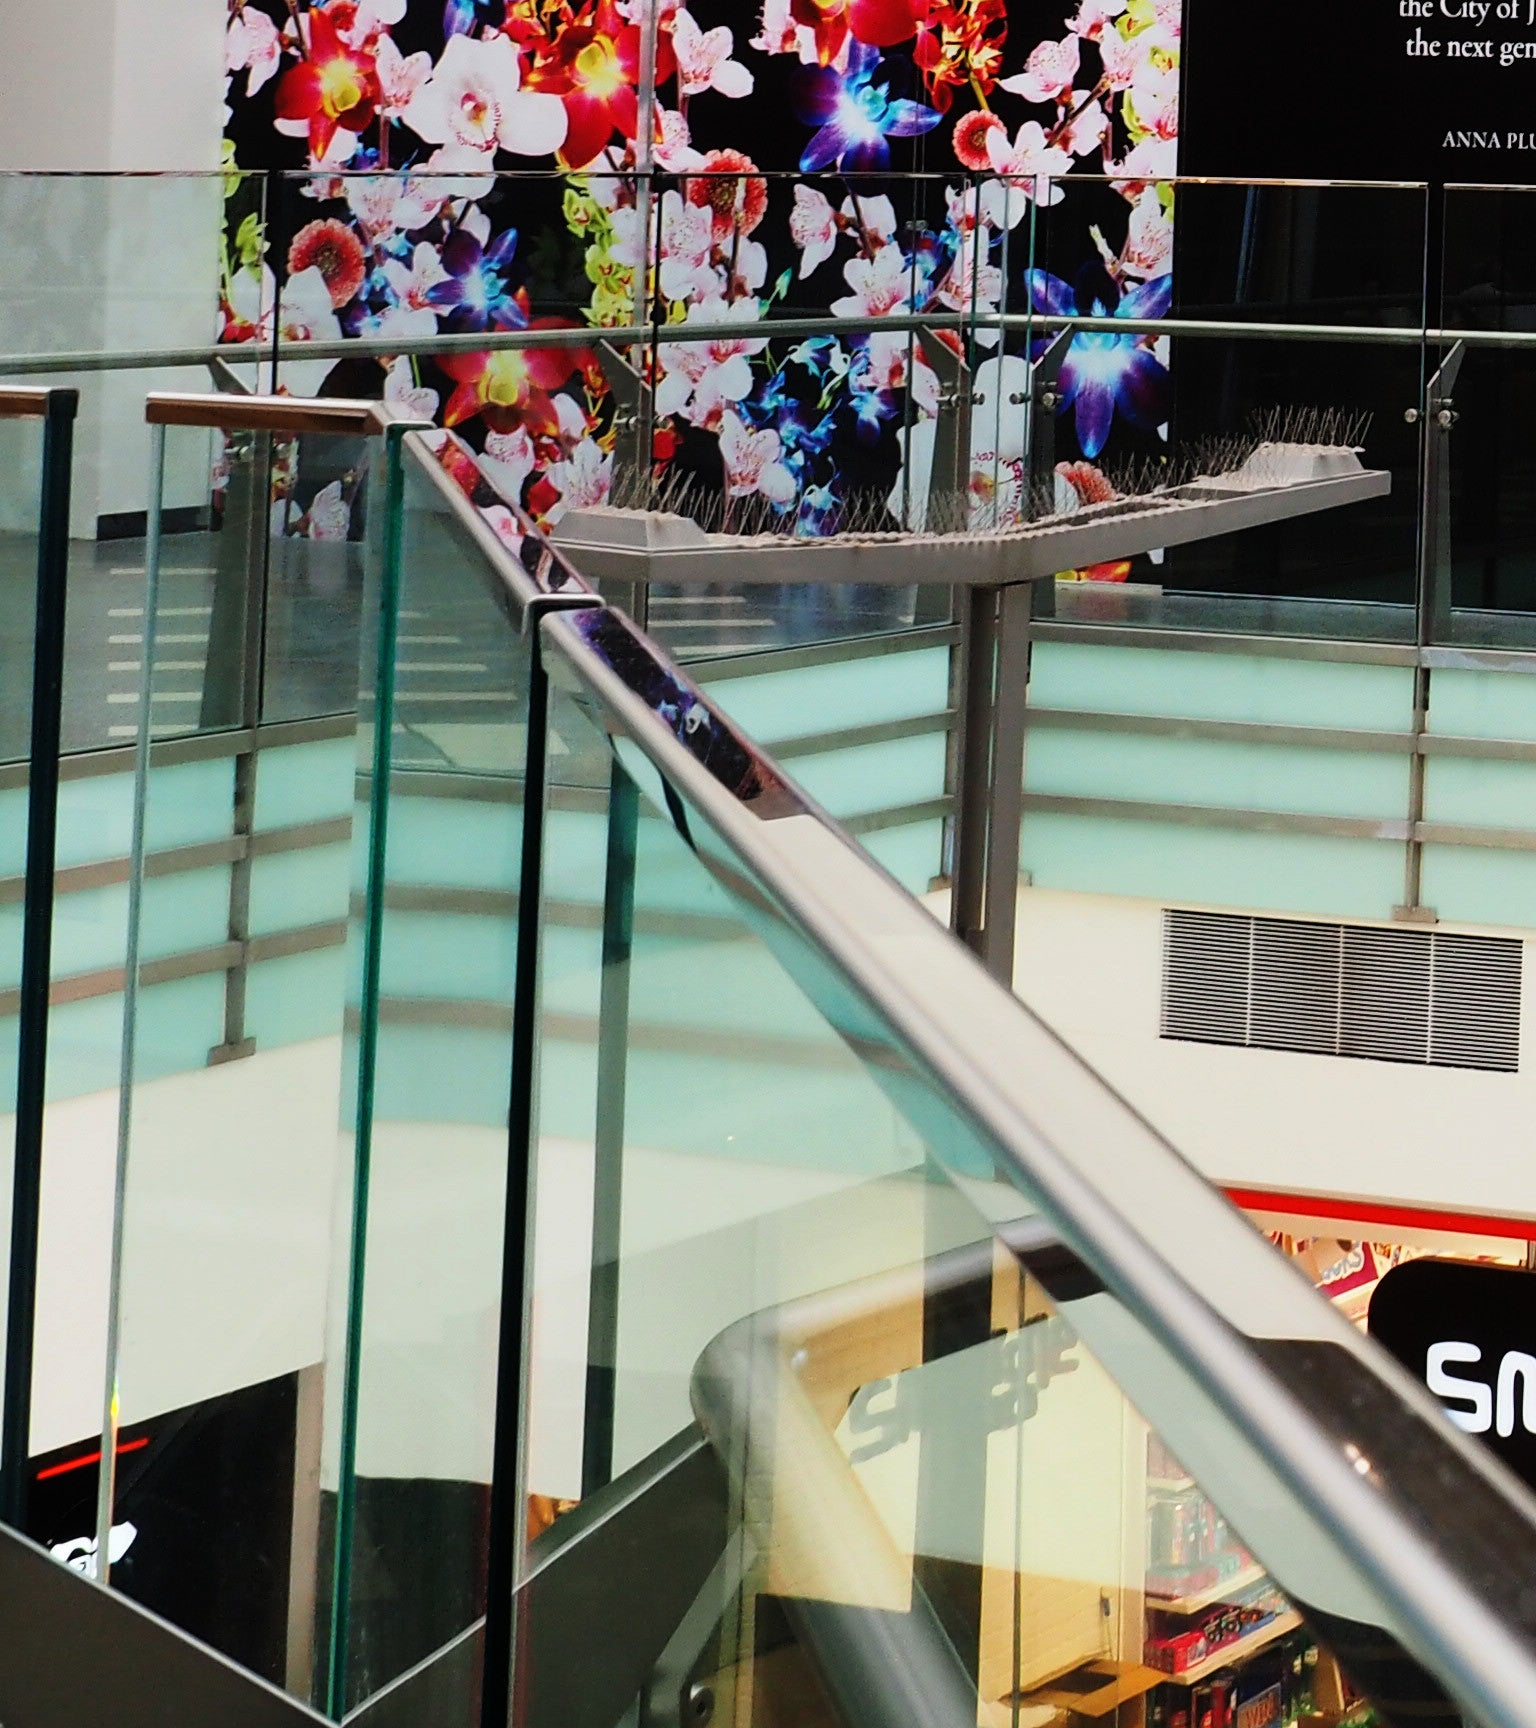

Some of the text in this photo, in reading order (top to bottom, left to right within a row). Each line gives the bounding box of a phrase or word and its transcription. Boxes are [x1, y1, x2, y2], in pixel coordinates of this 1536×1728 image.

[1407, 27, 1441, 56] the
[1447, 41, 1493, 57] next
[1443, 131, 1500, 148] ANNA
